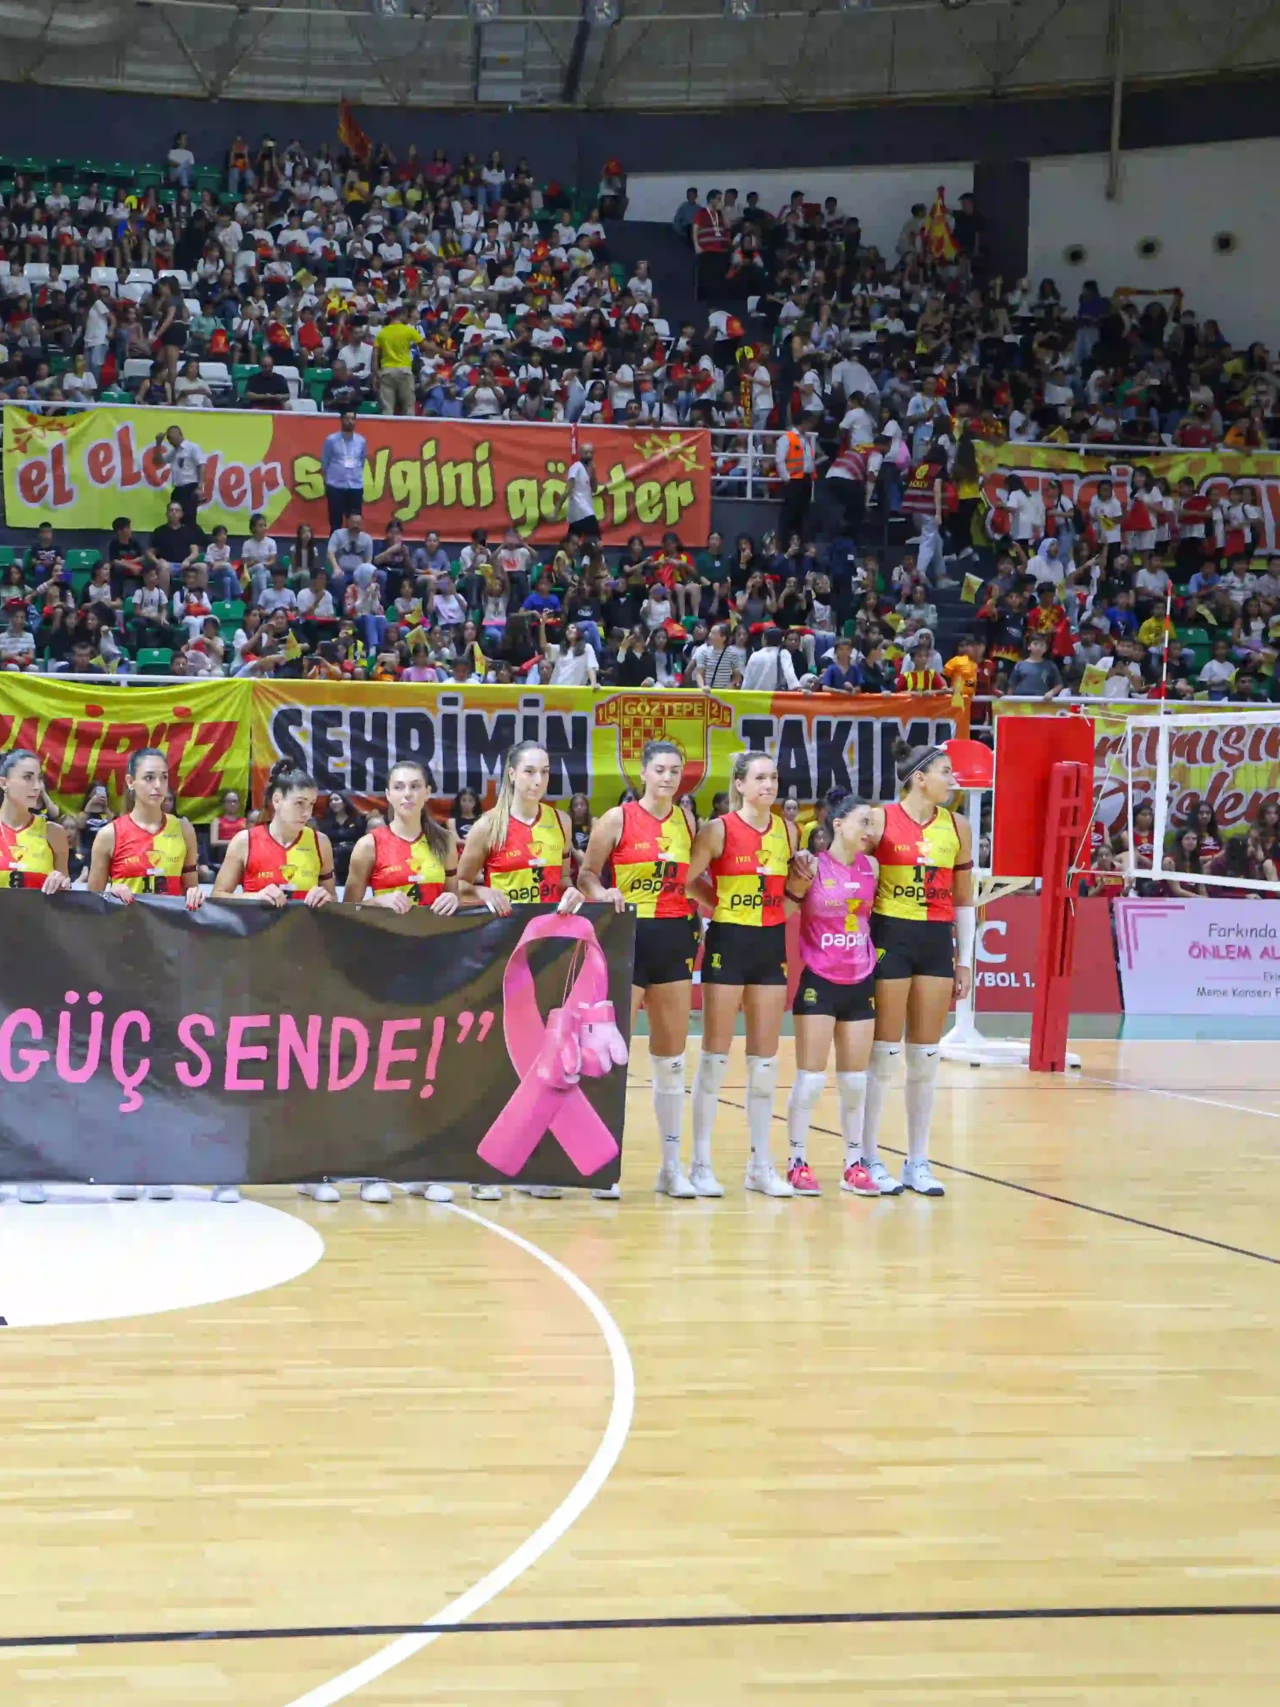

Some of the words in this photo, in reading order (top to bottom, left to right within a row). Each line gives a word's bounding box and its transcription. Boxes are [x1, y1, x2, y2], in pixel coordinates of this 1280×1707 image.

[293, 439, 494, 522] svgini
[624, 698, 704, 716] GÖZTEPE
[741, 719, 952, 800] TAKIM
[531, 866, 544, 884] 3
[652, 861, 678, 879] 10
[913, 866, 938, 883] 17
[757, 875, 766, 892] 1
[406, 884, 423, 902] 4
[844, 914, 859, 933] 2
[1188, 941, 1252, 960] ÖNLEM
[1197, 986, 1228, 998] Meme
